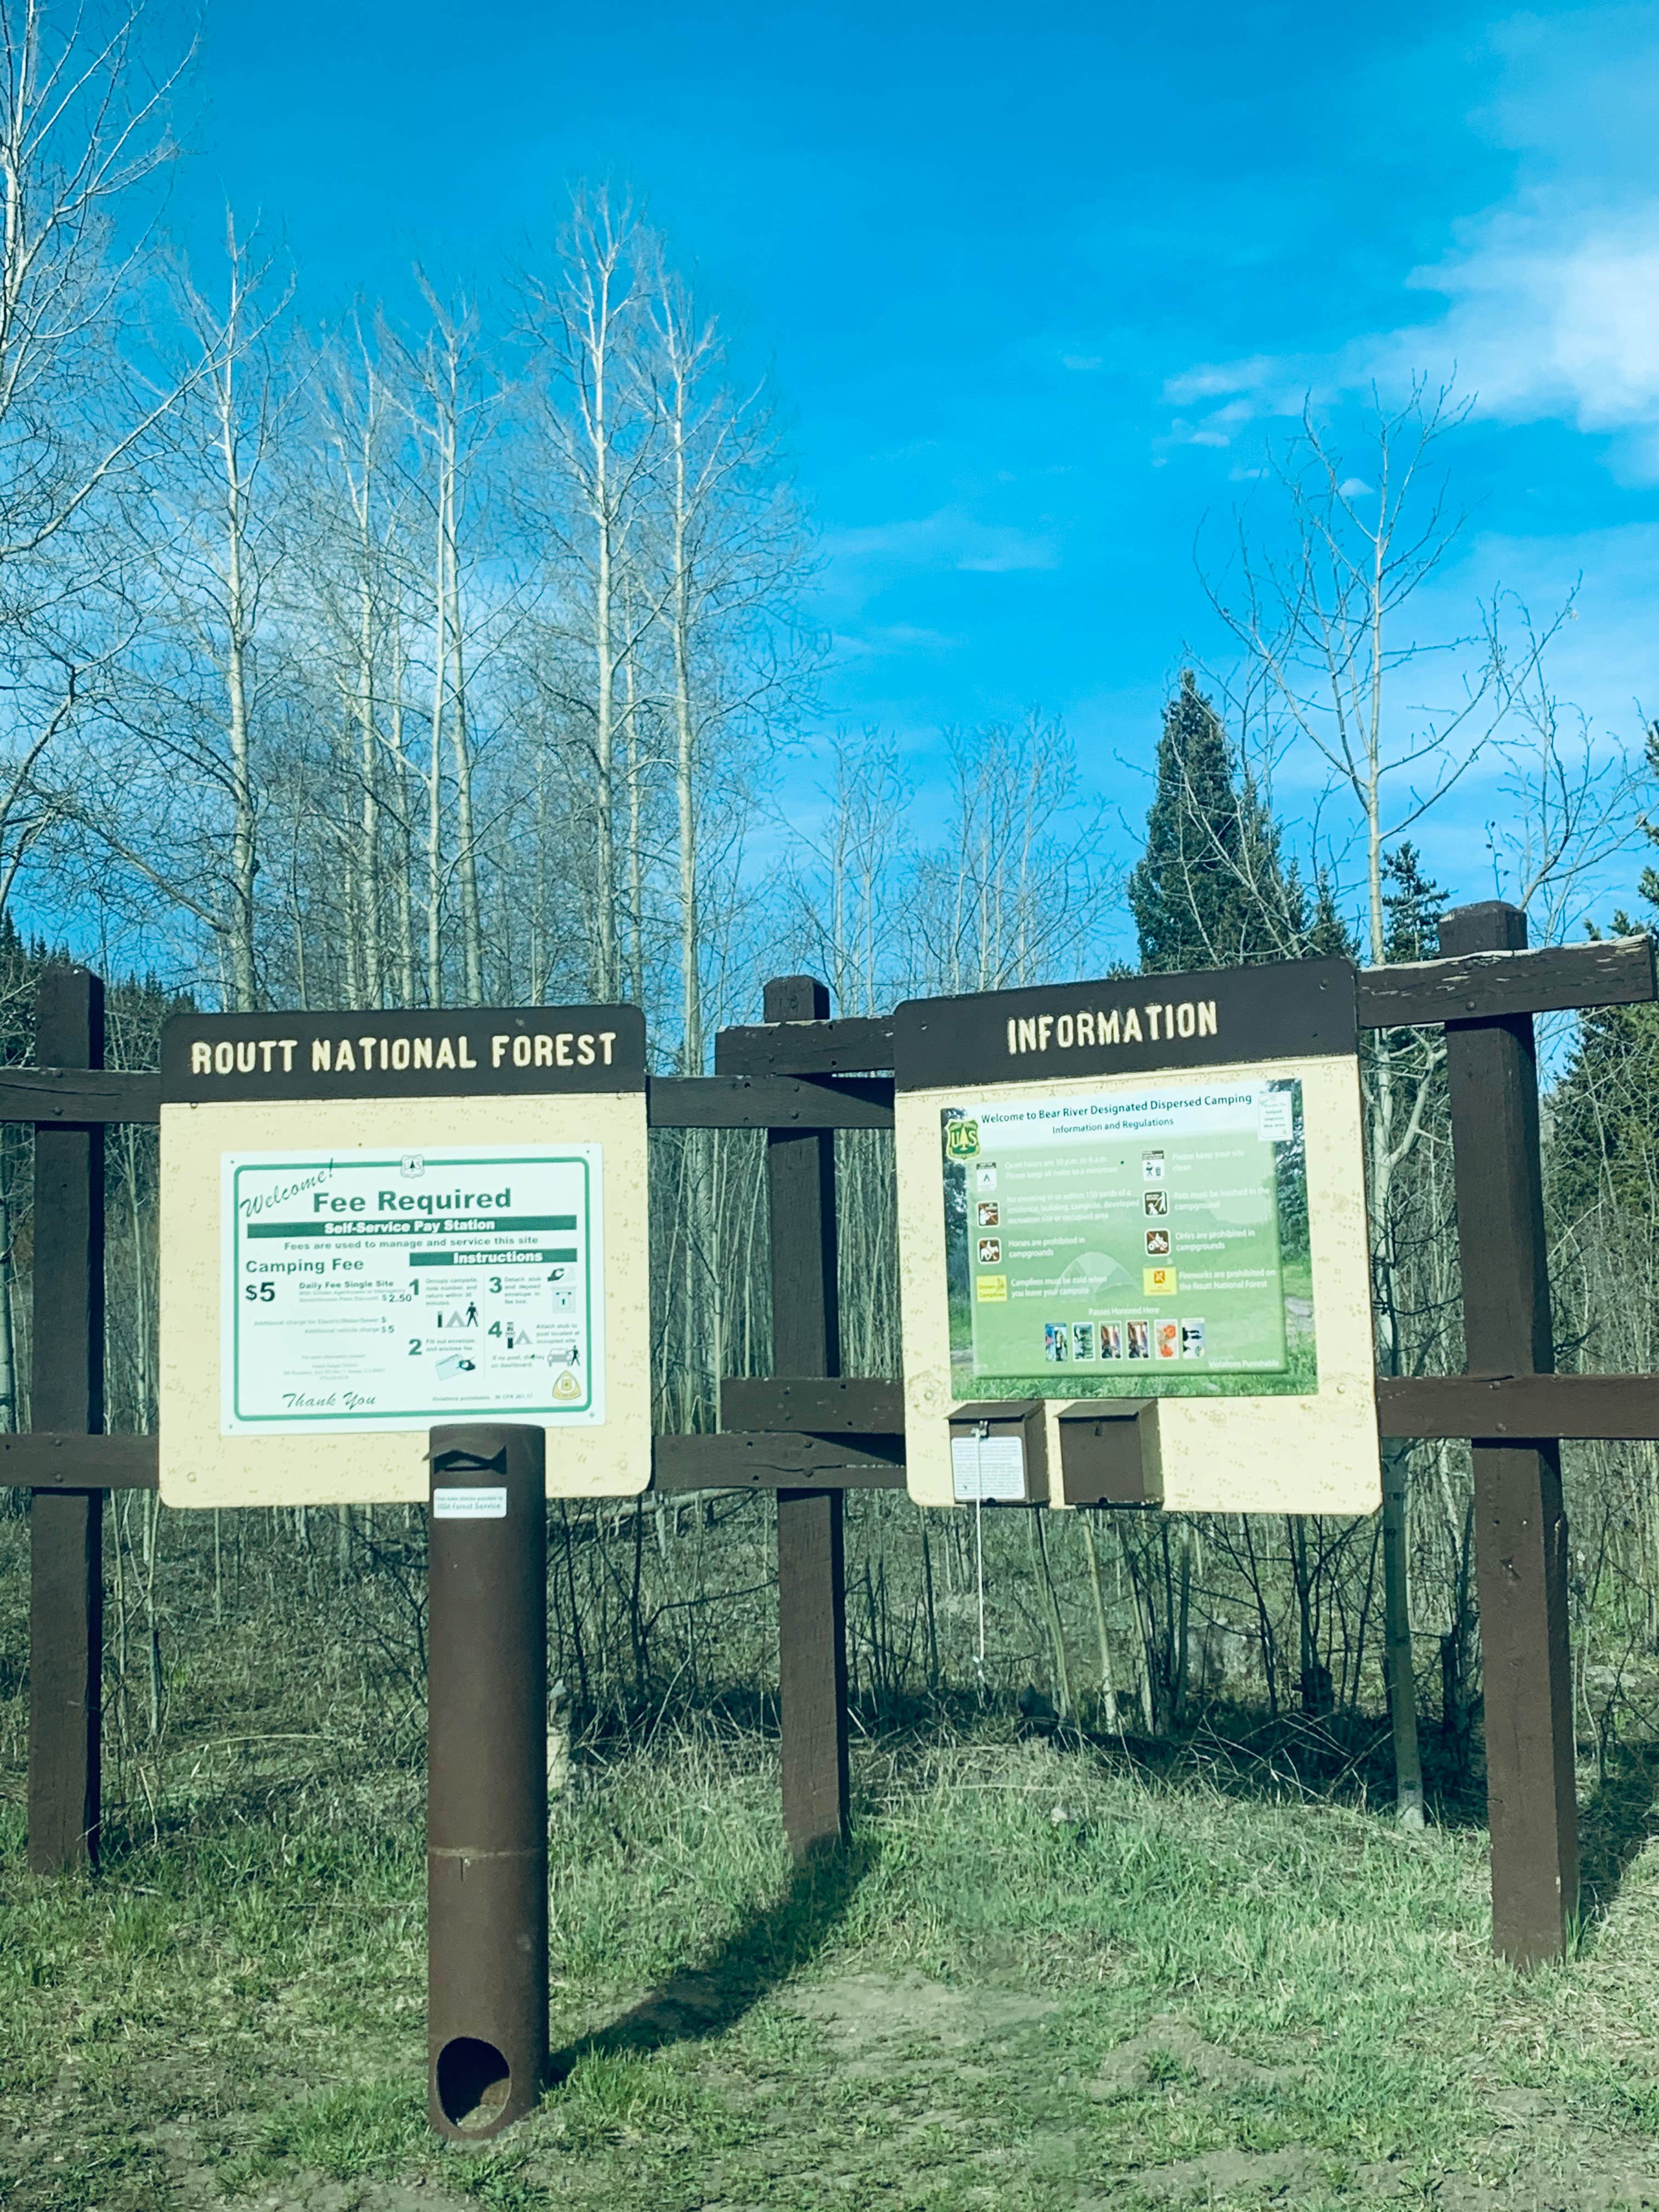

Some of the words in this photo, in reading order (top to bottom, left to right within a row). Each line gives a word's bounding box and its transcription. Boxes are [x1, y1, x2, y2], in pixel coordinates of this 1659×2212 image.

[1007, 1001, 1217, 1054] INFORMATION
[192, 1040, 298, 1074] ROUTT
[312, 1036, 477, 1072] NATIONAL
[492, 1032, 616, 1068] FOREST
[981, 1112, 1024, 1124] Welcome
[1040, 1110, 1060, 1119] Bear
[1063, 1107, 1087, 1117] River
[1091, 1101, 1147, 1116] Designated
[1151, 1097, 1201, 1110] Dispersed
[1205, 1094, 1252, 1106] Camping
[1053, 1122, 1102, 1134] Information
[1105, 1121, 1120, 1130] and
[1123, 1118, 1174, 1130] Regulations
[240, 1158, 334, 1217] Welcome!
[1209, 1189, 1219, 1198] be
[1257, 1186, 1271, 1195] the
[313, 1192, 366, 1212] Fee
[378, 1188, 511, 1215] Required
[1175, 1200, 1221, 1211] campground
[324, 1220, 410, 1234] Self-Service
[414, 1220, 441, 1233] Pay
[444, 1218, 495, 1231] Station
[1175, 1232, 1195, 1240] OHVs
[1209, 1229, 1246, 1240] prohibited
[1248, 1228, 1256, 1237] in
[285, 1242, 310, 1250] Fees
[380, 1239, 422, 1249] manage
[427, 1238, 446, 1246] and
[494, 1237, 515, 1245] this
[518, 1236, 538, 1244] site
[1008, 1239, 1031, 1247] Horses
[1043, 1236, 1077, 1246] prohibited
[1176, 1241, 1226, 1252] campgrounds
[453, 1251, 543, 1264] Instructions
[1009, 1248, 1054, 1259] campgrounds
[246, 1260, 325, 1274] Camping
[332, 1258, 364, 1270] Fee
[1179, 1270, 1213, 1280] Fireworks
[1226, 1268, 1265, 1279] prohibited
[409, 1278, 420, 1295] 1
[489, 1277, 503, 1294] 3
[1011, 1277, 1043, 1288] Campfires
[1045, 1277, 1062, 1285] must
[1063, 1276, 1071, 1284] be
[1072, 1276, 1087, 1284] cold
[1193, 1282, 1212, 1290] Routt
[1214, 1280, 1244, 1289] National
[1245, 1279, 1268, 1288] Forest
[245, 1281, 275, 1302] $5
[1012, 1290, 1024, 1299] you
[1025, 1288, 1042, 1297] leave
[1043, 1289, 1059, 1298] your
[1059, 1287, 1089, 1296] campsite
[1088, 1307, 1110, 1316] Passes
[1111, 1306, 1142, 1315] Honored
[1143, 1305, 1160, 1314] Here
[488, 1321, 503, 1338] 4
[408, 1339, 422, 1356] 2
[282, 1392, 336, 1408] Thank
[343, 1391, 376, 1410] You
